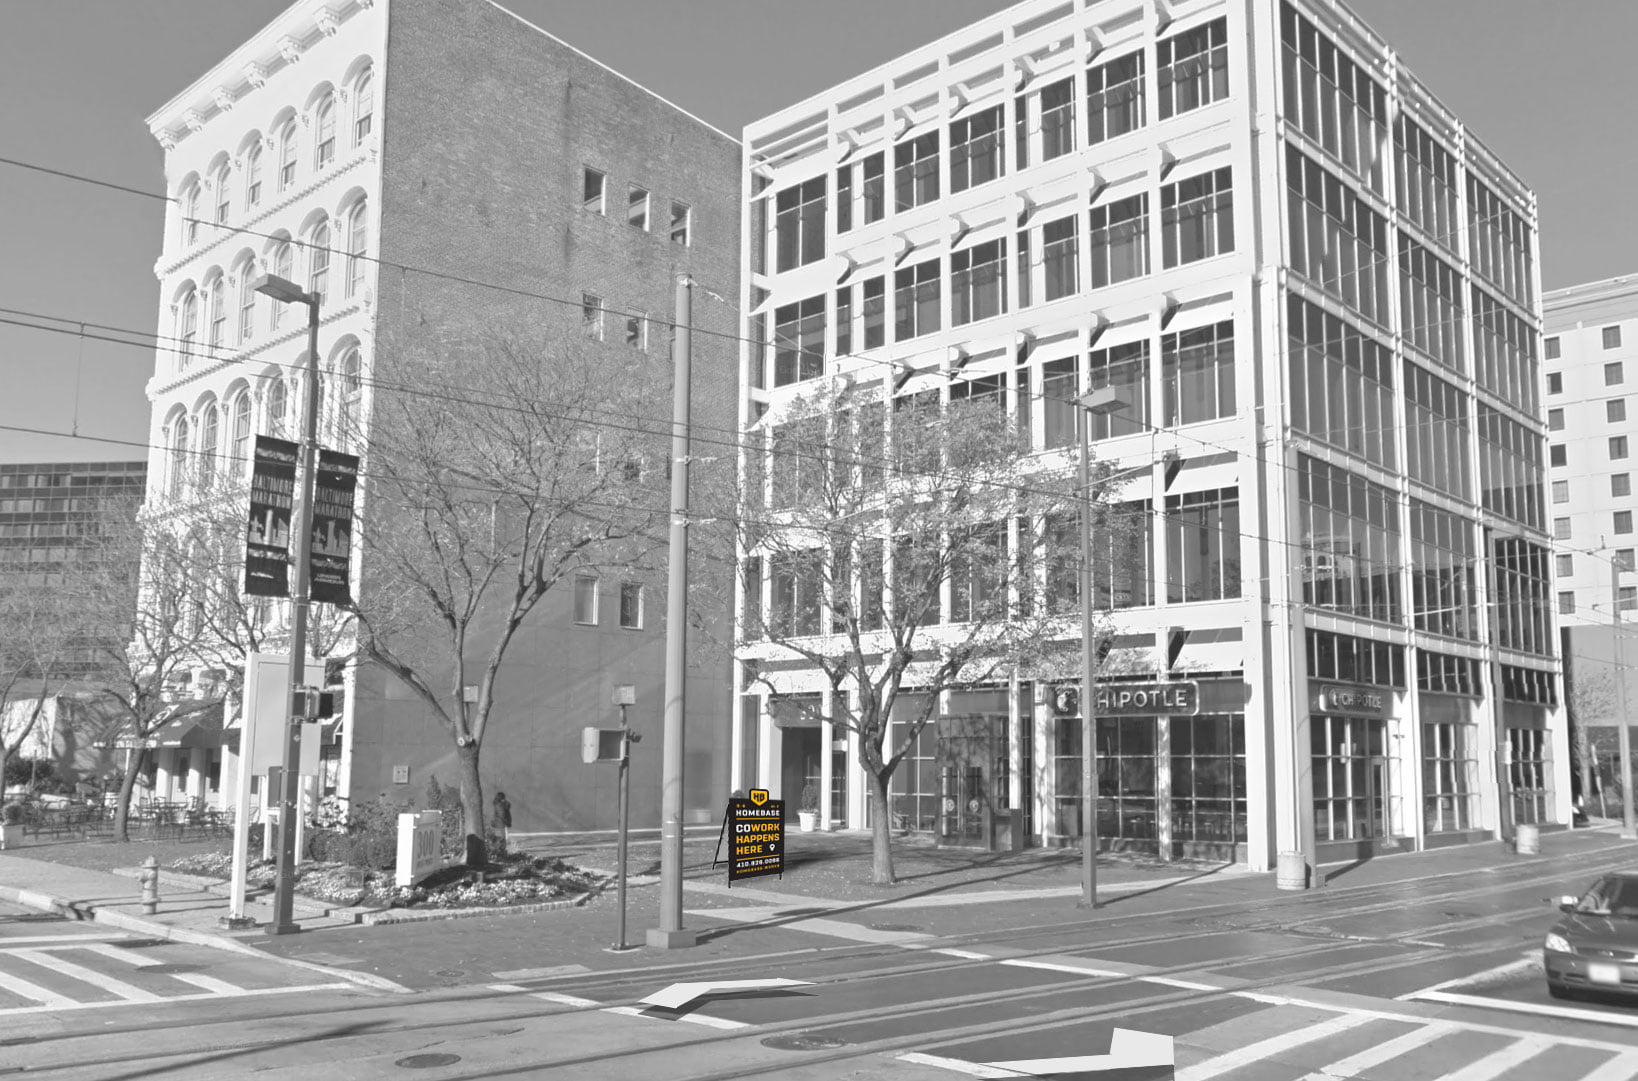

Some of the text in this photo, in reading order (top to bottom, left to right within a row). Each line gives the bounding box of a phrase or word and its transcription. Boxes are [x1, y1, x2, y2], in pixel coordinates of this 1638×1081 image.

[253, 473, 295, 495] BALTIMORE
[251, 490, 292, 510] MARATHON
[1096, 689, 1188, 708] HIPOTLE
[735, 809, 780, 817] HOMEBASE
[735, 823, 780, 833] COWORK
[735, 833, 780, 844] HAPPENS
[735, 844, 763, 855] HERE
